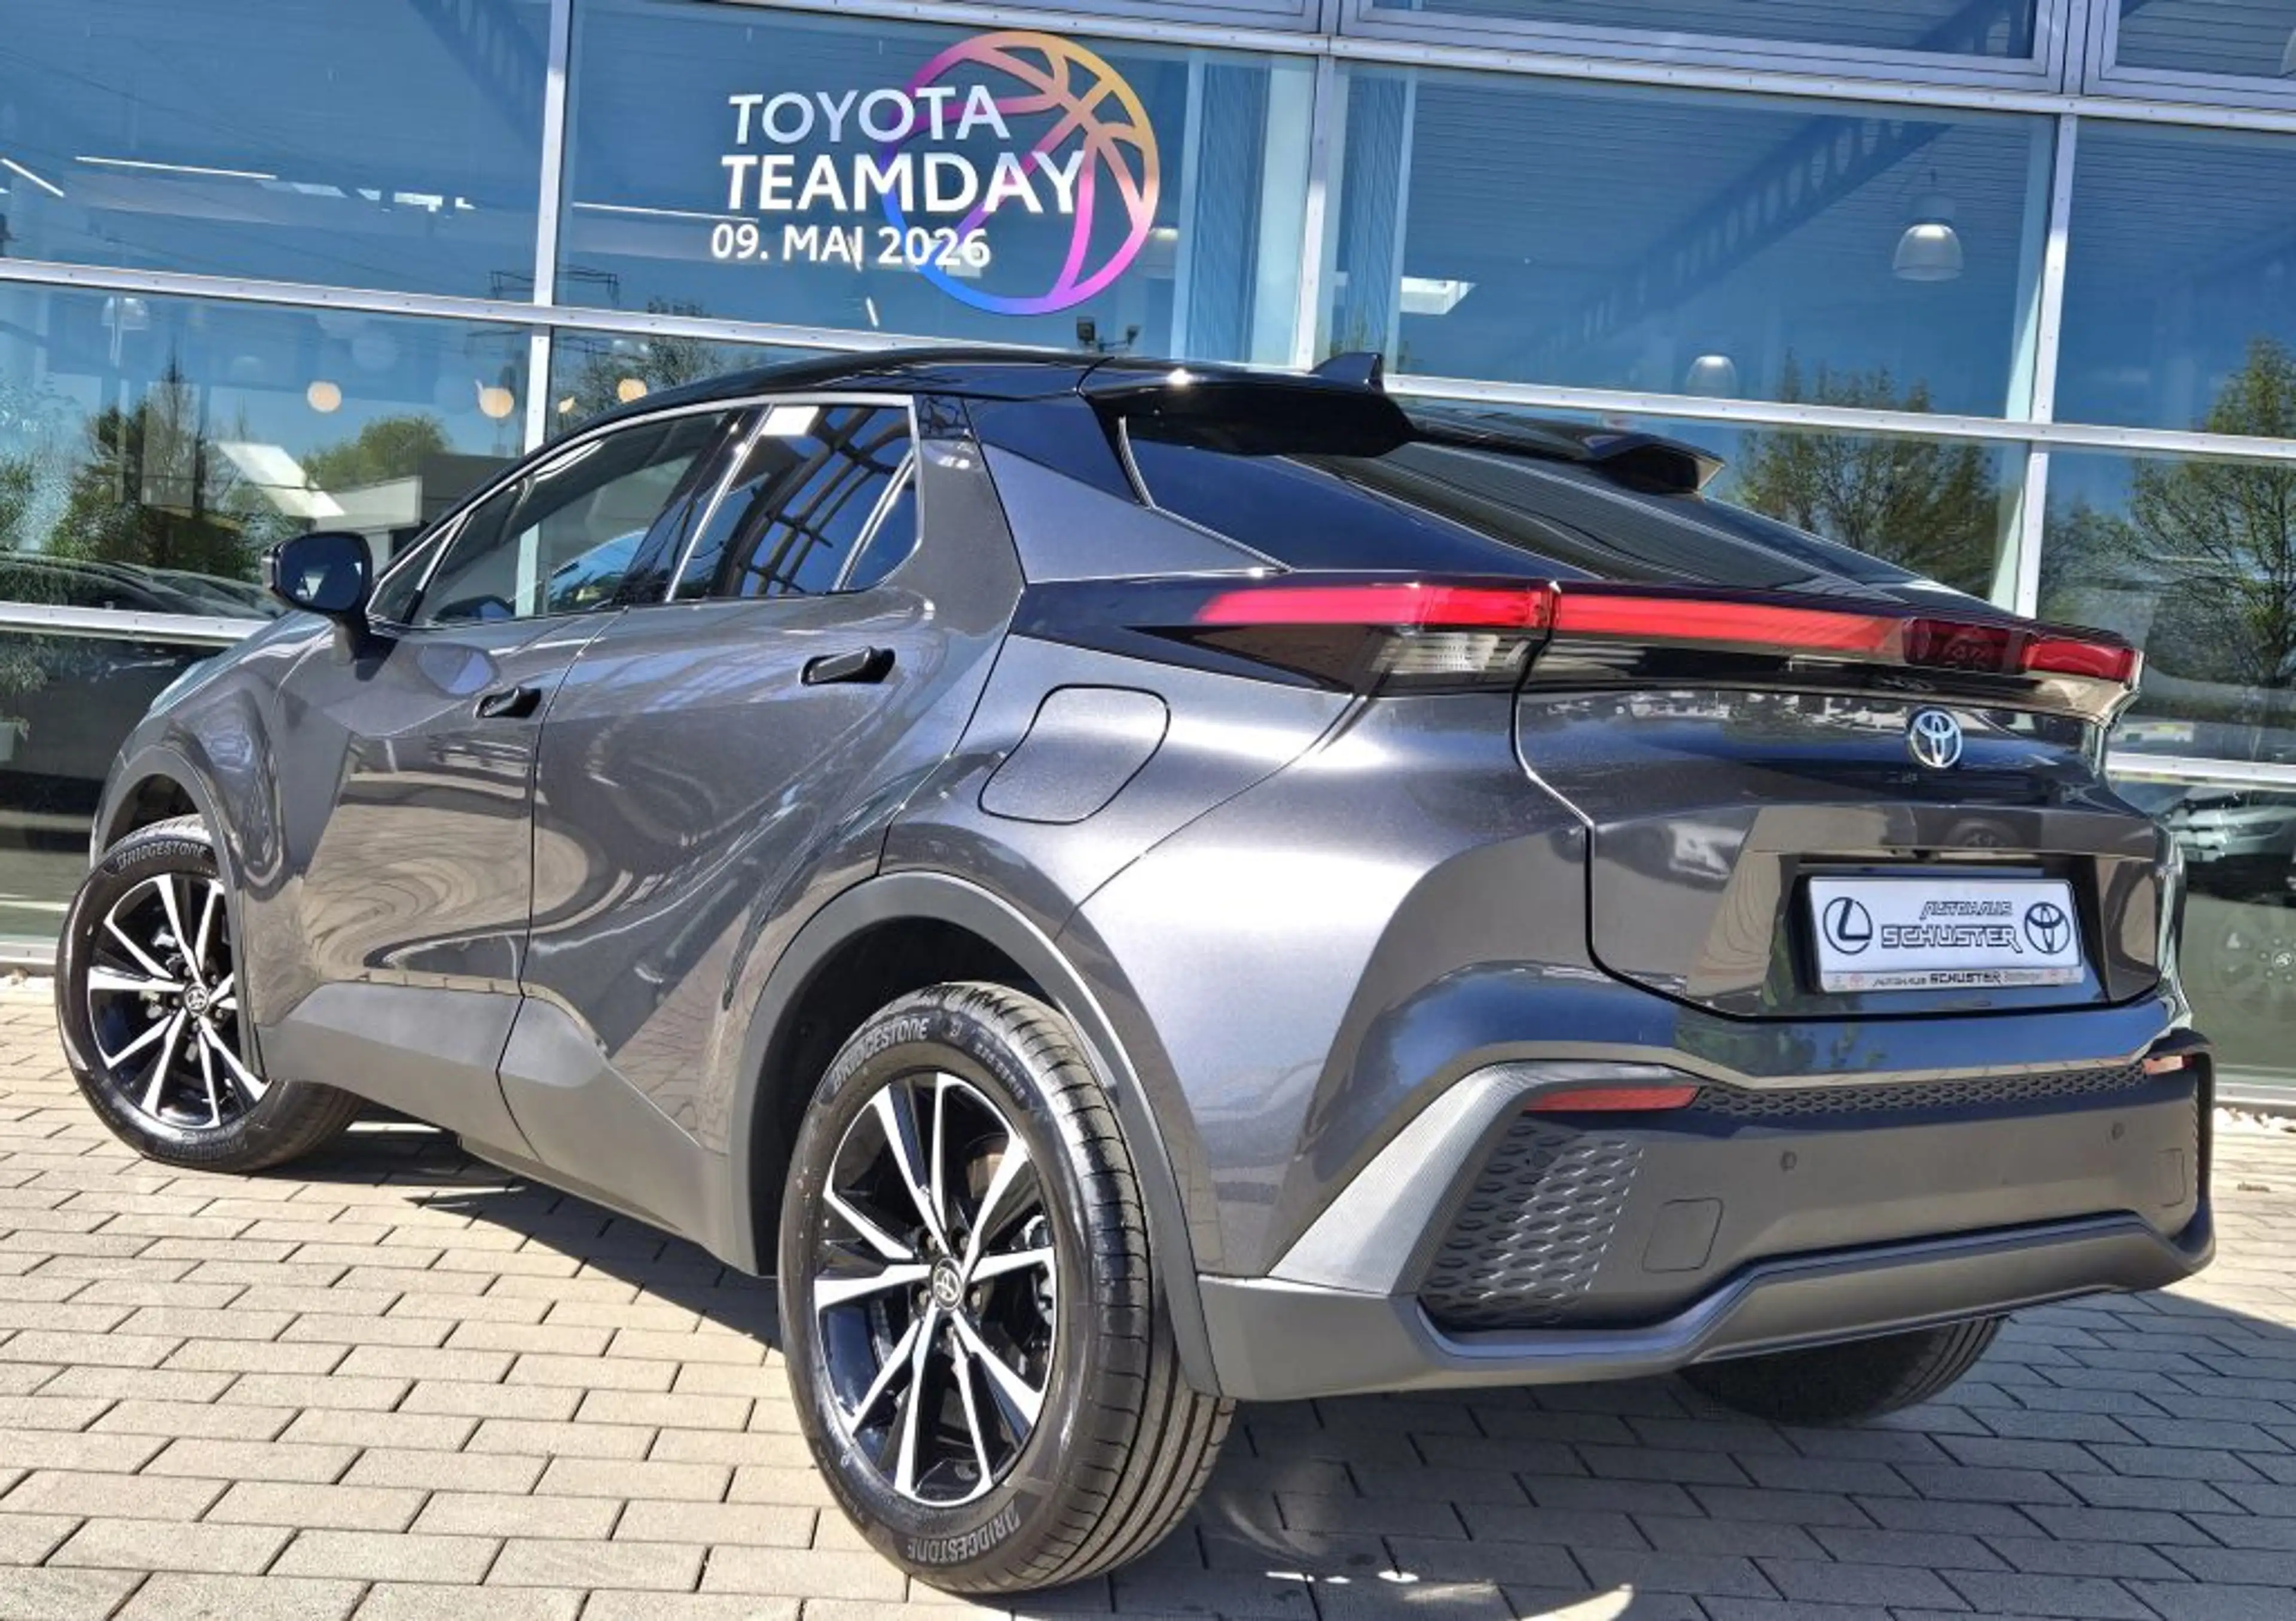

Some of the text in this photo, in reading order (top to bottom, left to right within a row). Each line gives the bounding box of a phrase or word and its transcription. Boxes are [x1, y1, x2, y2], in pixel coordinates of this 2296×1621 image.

[729, 84, 1010, 145] TOYOTA
[721, 151, 1085, 214] TEAMDAY
[712, 223, 991, 267] 09. MAI 2026
[1880, 924, 2024, 954] SCHUSTER
[1929, 970, 2002, 986] SCHUSTER
